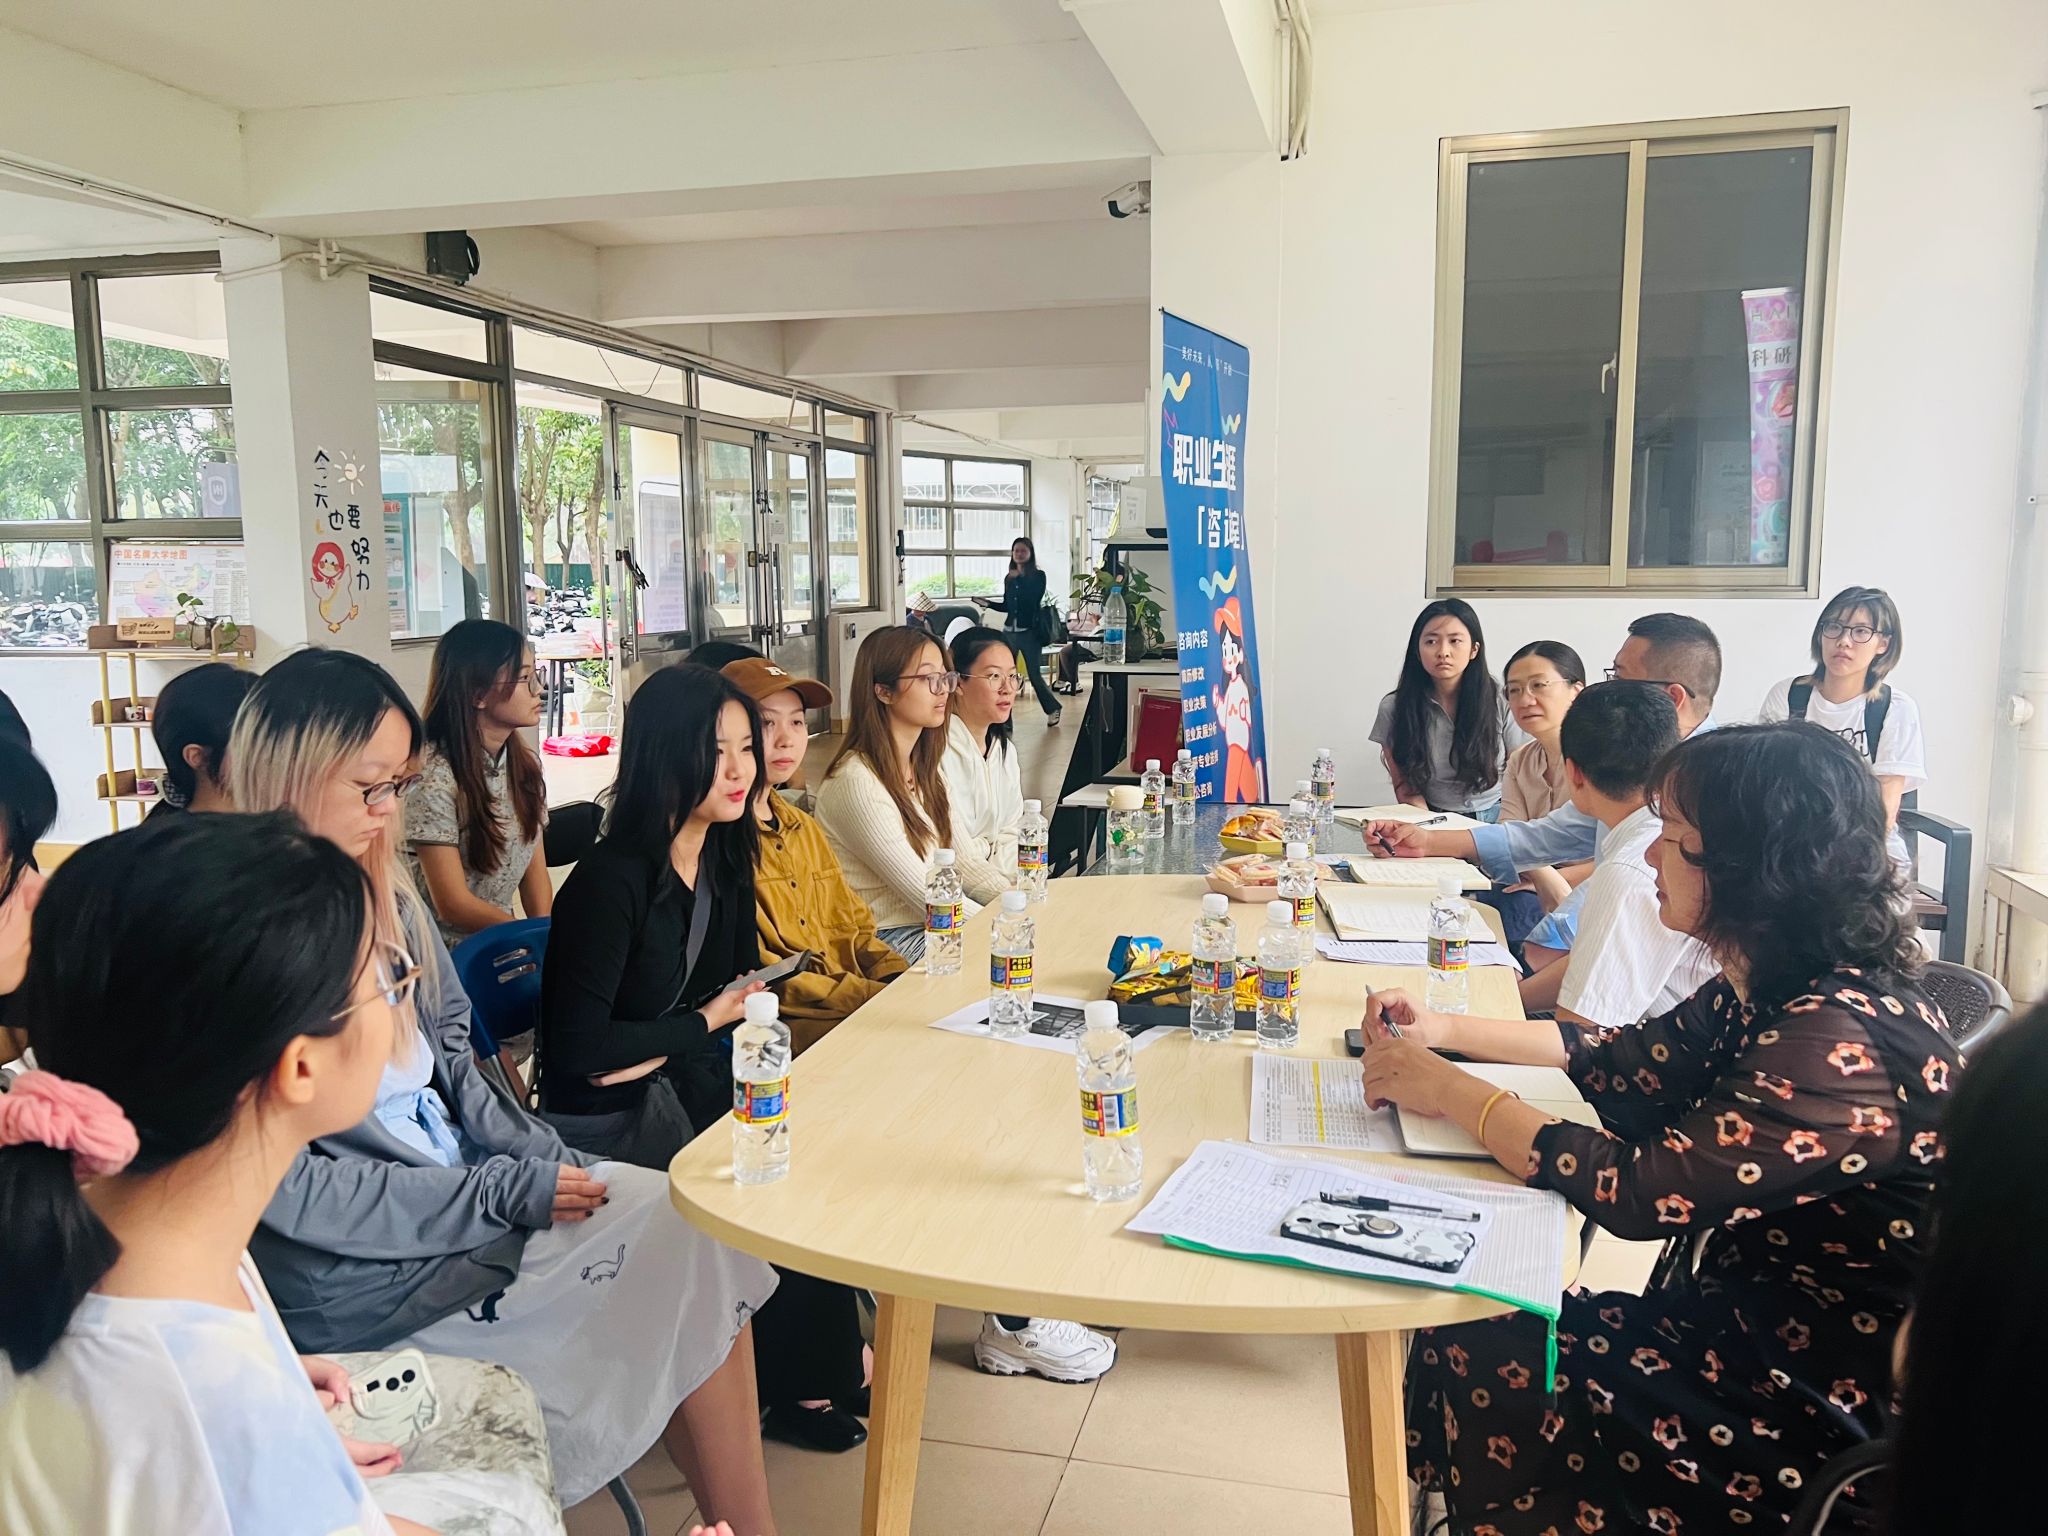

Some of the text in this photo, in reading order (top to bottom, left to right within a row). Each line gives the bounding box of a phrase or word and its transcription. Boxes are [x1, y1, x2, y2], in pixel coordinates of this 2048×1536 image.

[1173, 433, 1237, 491] 职业生涯
[1178, 629, 1209, 651] 咨询内容
